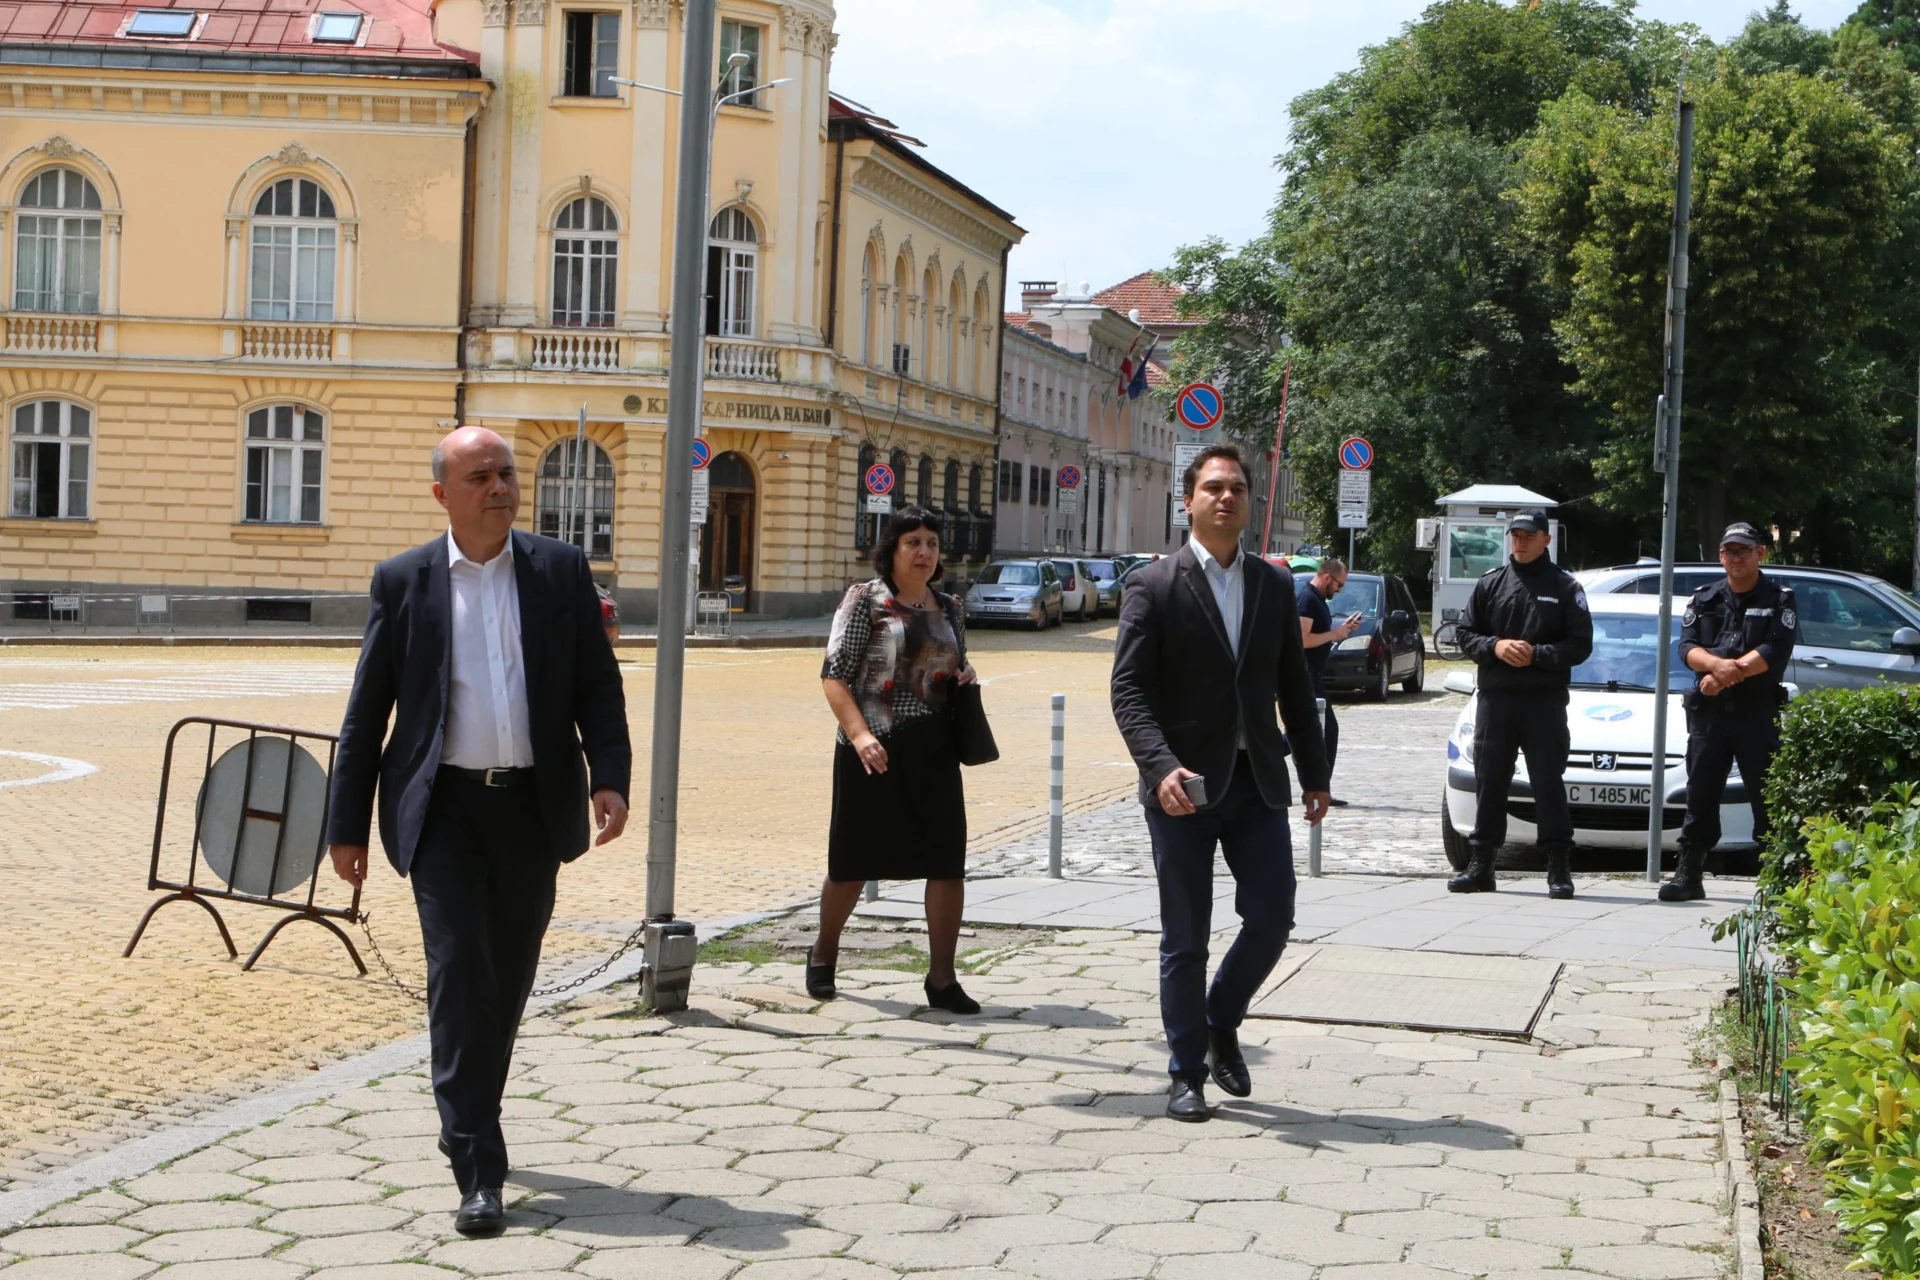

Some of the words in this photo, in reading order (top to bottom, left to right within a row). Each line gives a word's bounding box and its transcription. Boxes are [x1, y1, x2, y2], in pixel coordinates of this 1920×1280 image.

[783, 406, 801, 422] НА
[802, 407, 823, 424] БАН
[1569, 786, 1580, 802] C
[1590, 786, 1627, 803] 1485
[1629, 788, 1651, 804] MC
